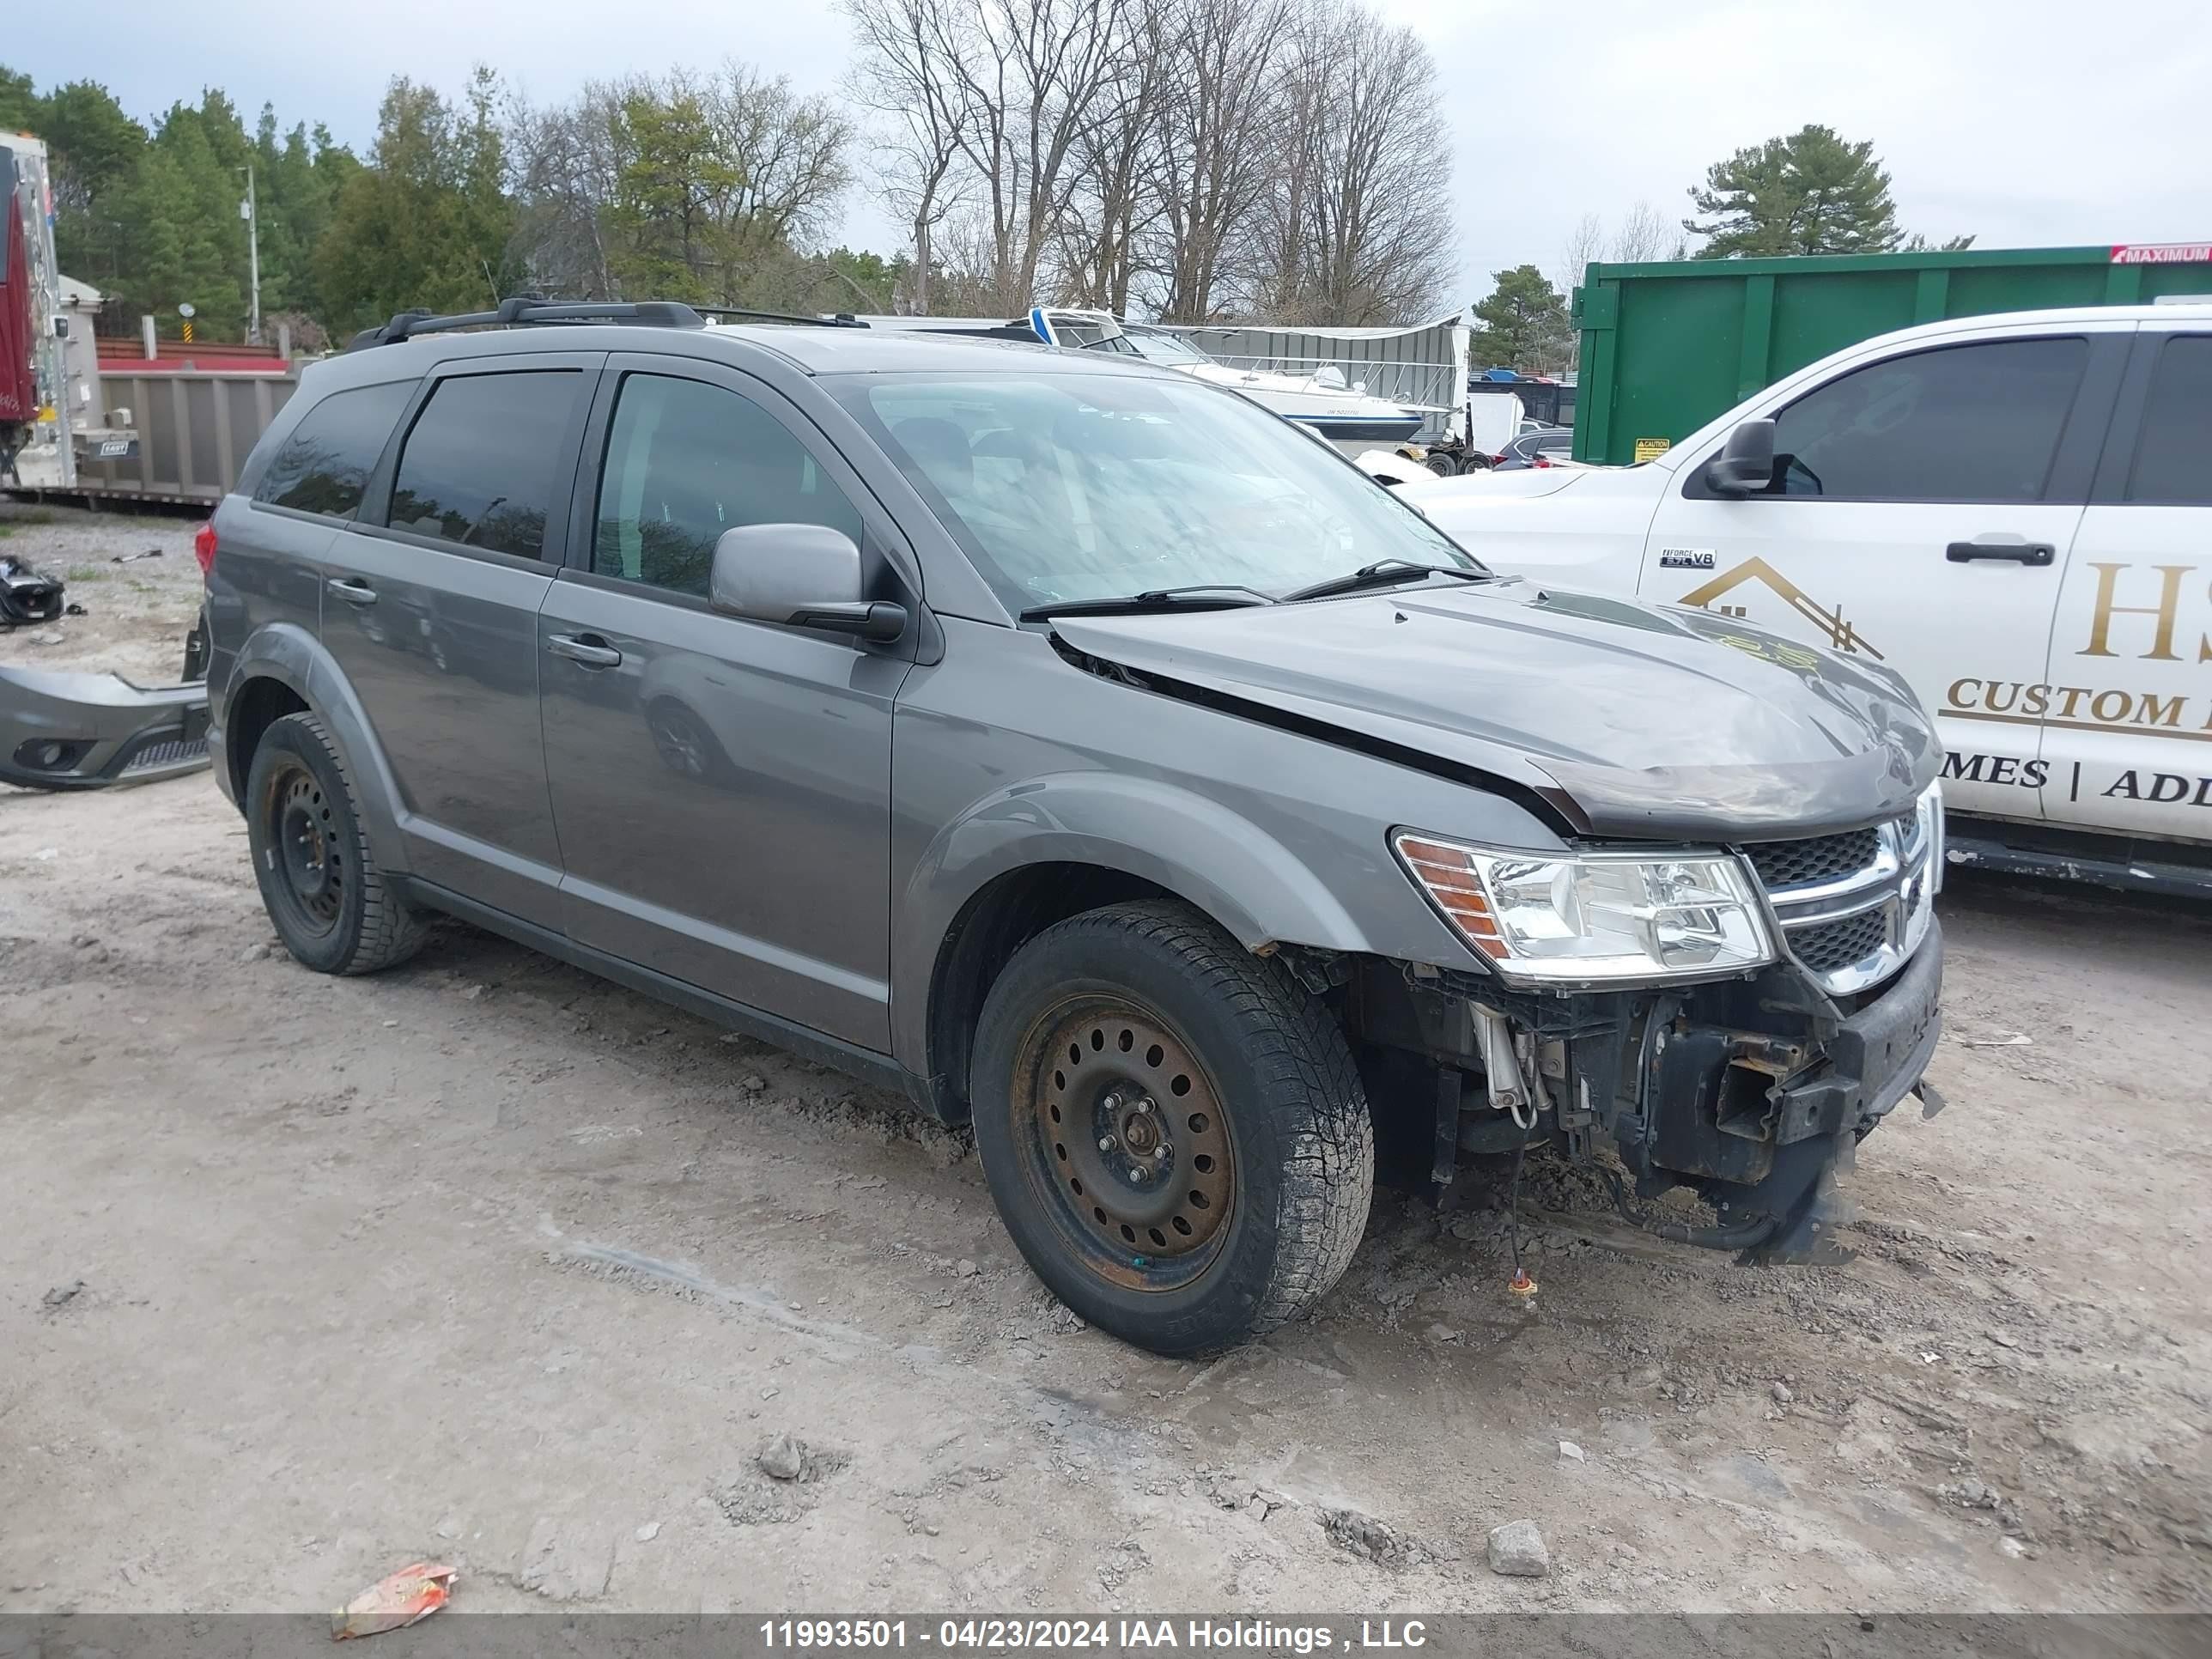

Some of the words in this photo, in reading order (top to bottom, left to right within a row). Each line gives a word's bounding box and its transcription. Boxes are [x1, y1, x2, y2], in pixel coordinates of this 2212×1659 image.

[2126, 246, 2210, 263] MAXIMUM
[1694, 553, 1713, 564] V8
[1948, 678, 2190, 726] CUSTOM
